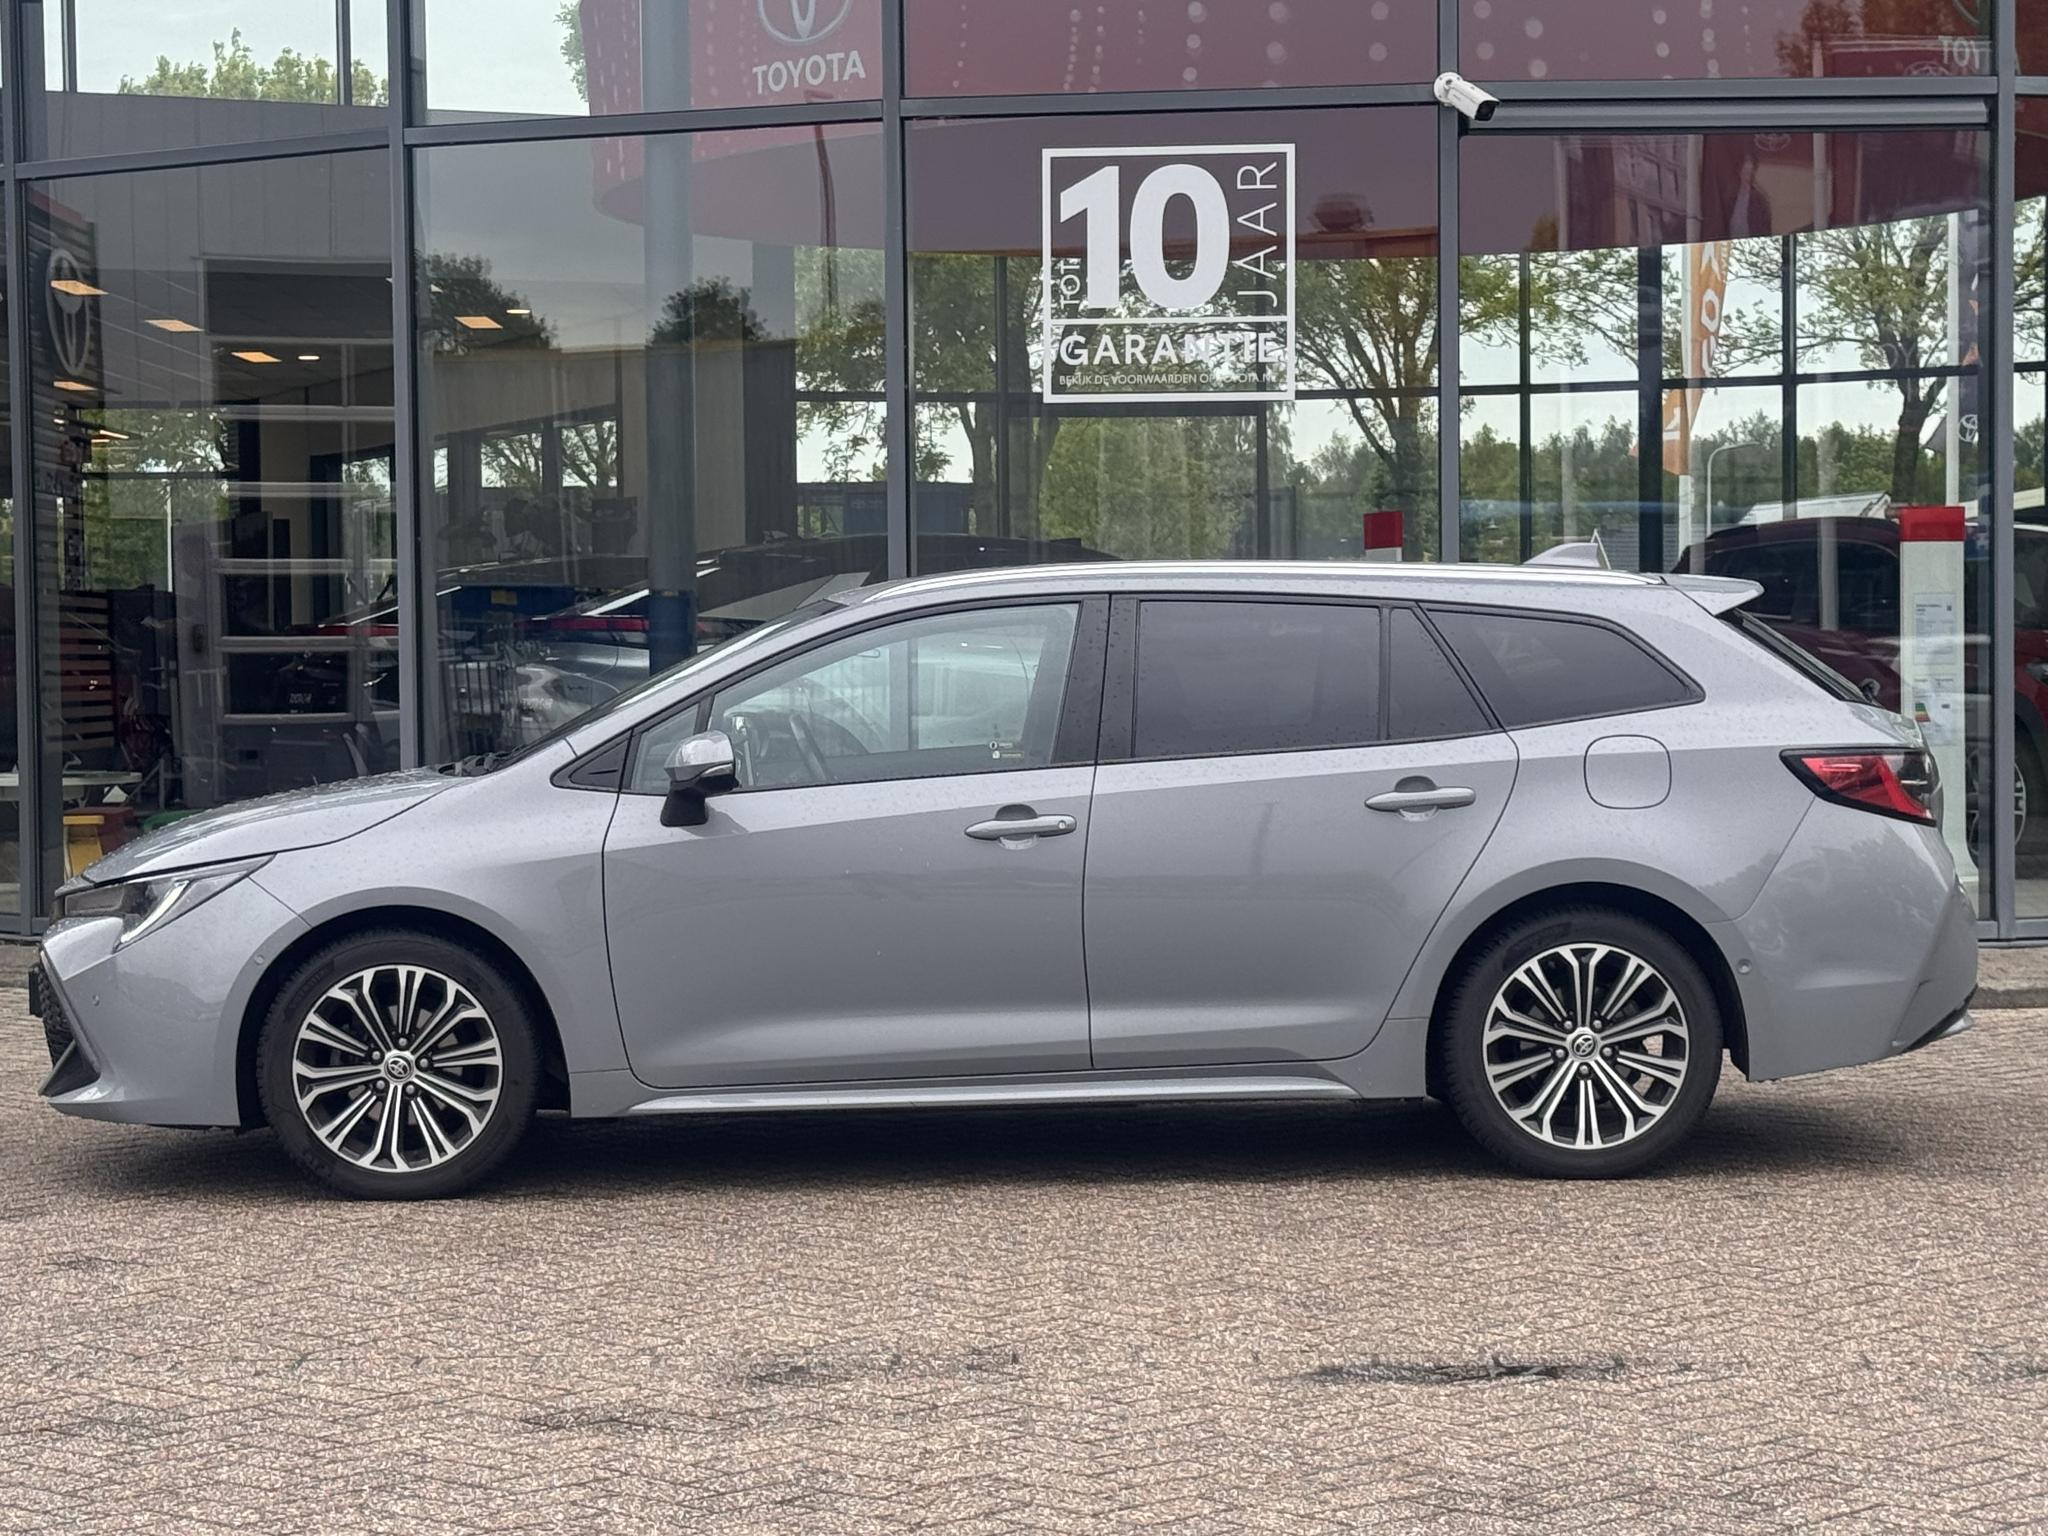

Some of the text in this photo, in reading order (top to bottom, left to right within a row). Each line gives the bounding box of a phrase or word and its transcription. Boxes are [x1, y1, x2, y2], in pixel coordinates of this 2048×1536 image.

[752, 50, 866, 95] TOYOTA
[1060, 163, 1230, 309] 10
[1236, 161, 1278, 308] JAAR
[1060, 259, 1081, 310] TOT
[1059, 332, 1279, 366] GARANTIE
[1059, 374, 1092, 386] BEKIJK
[1094, 374, 1109, 385] DE
[1111, 373, 1197, 385] VOORWAARDEN
